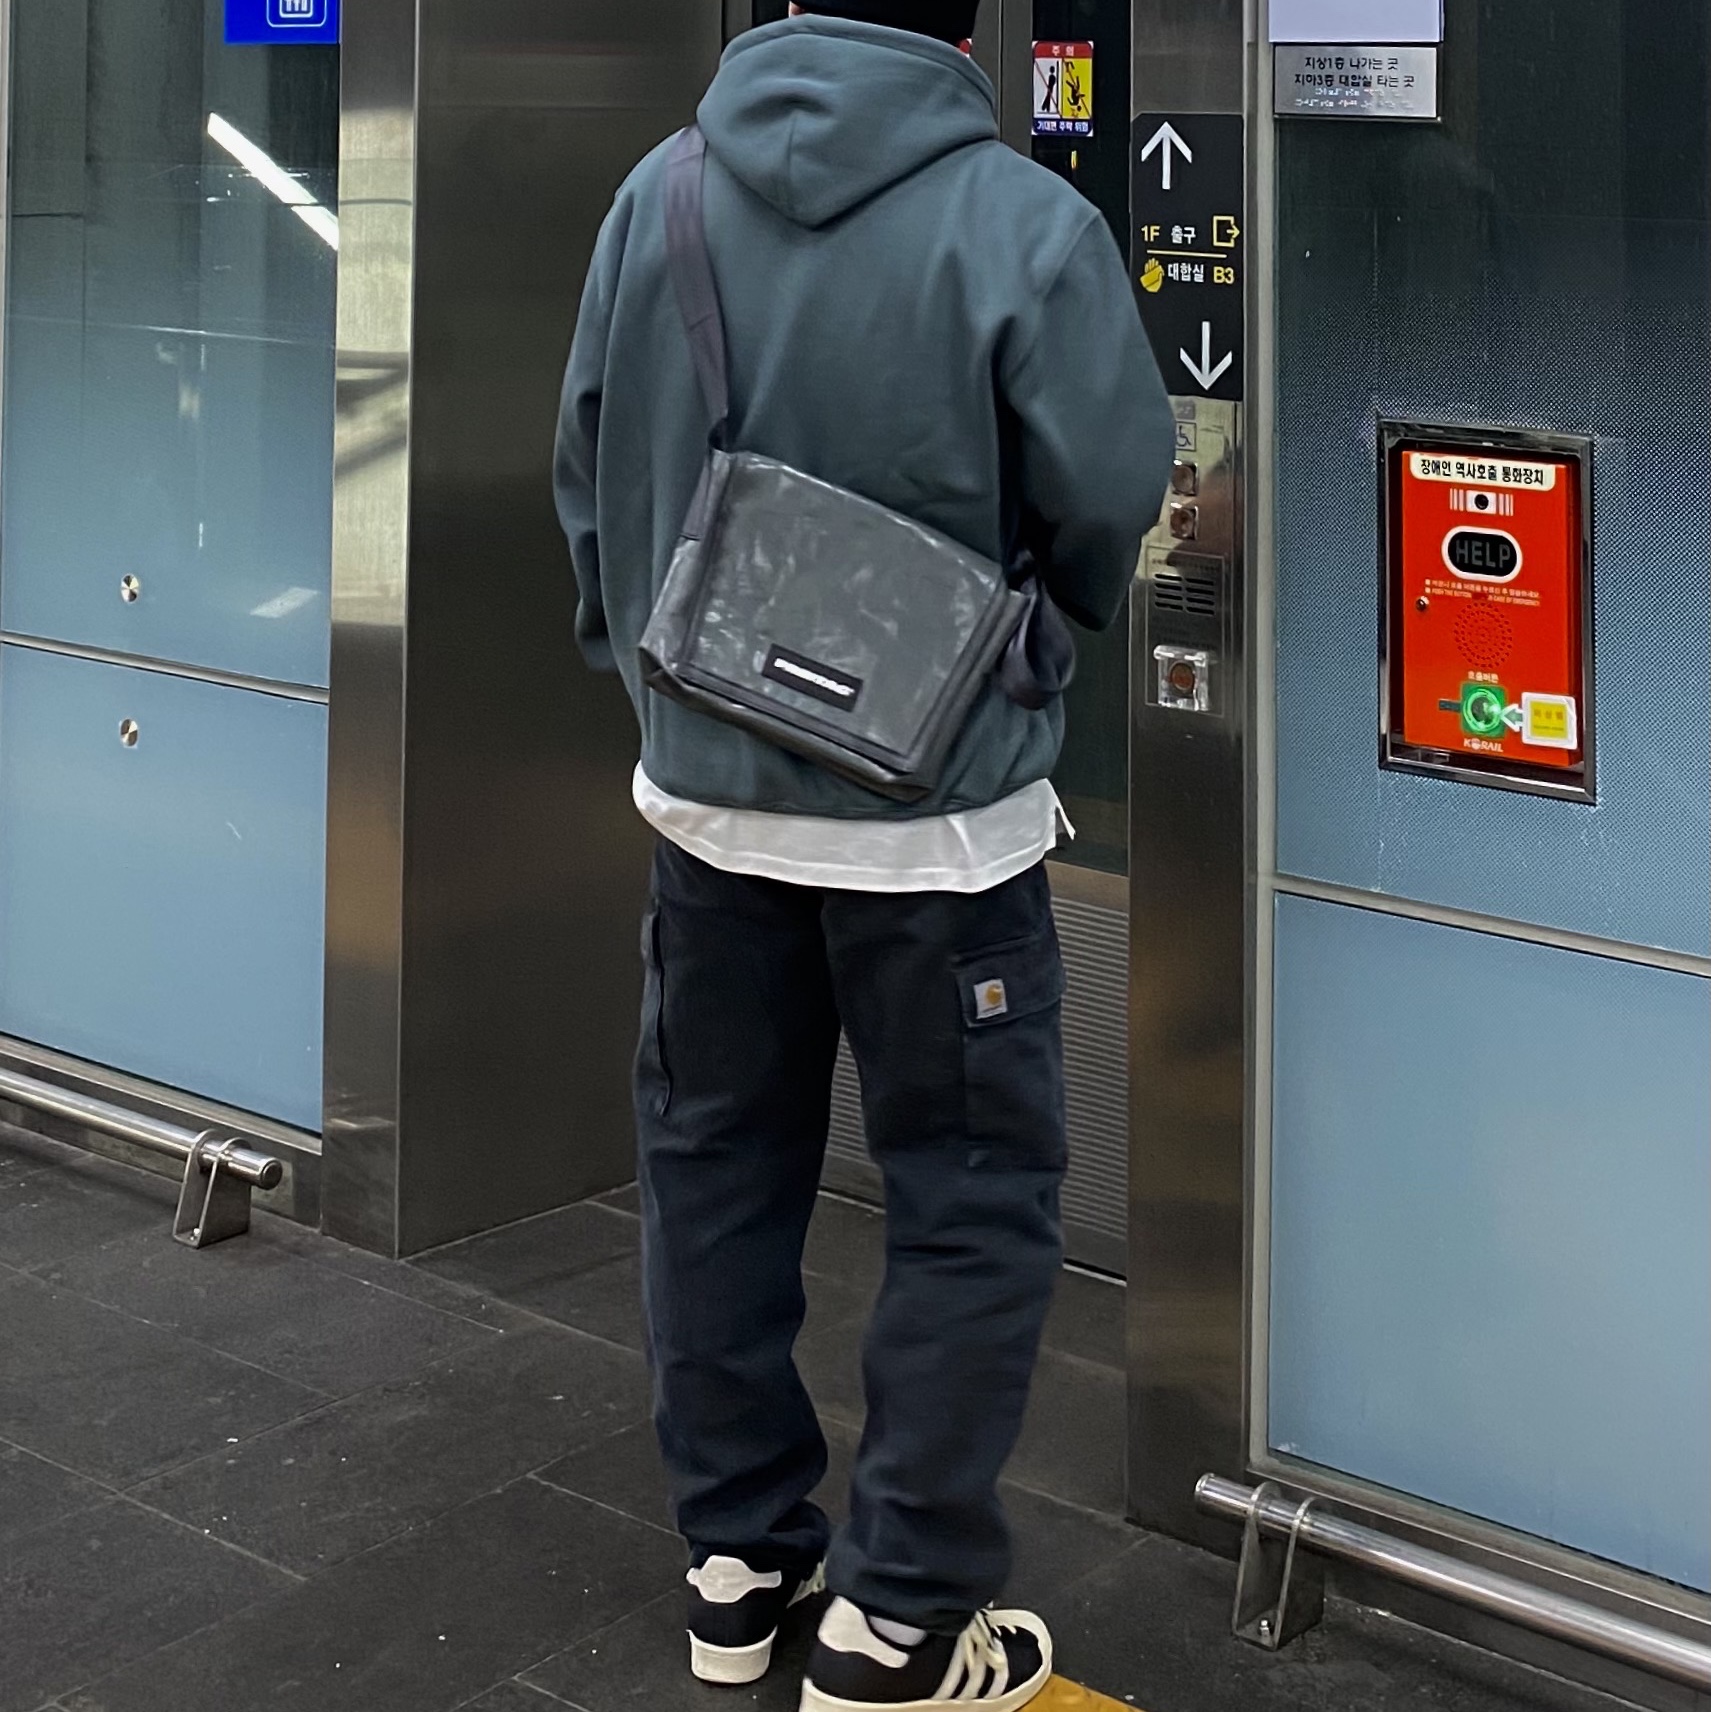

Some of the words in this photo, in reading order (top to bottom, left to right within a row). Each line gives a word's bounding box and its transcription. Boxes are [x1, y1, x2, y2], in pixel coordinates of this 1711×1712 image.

[1304, 56, 1345, 70] 지상1층
[1350, 57, 1383, 70] 나가는
[1387, 57, 1399, 70] 곳
[1377, 75, 1399, 88] 타는
[1403, 75, 1415, 88] 곳
[1059, 121, 1073, 132] 추락
[1141, 225, 1160, 242] 1F
[1171, 225, 1197, 245] 출구
[1167, 262, 1205, 283] 대합실
[1213, 266, 1235, 284] B3
[1420, 459, 1451, 477] 장애인
[1455, 461, 1498, 481] 역사호출
[1502, 465, 1544, 486] 통화장치
[1455, 539, 1511, 569] HELP
[1463, 737, 1504, 753] KORAIL
